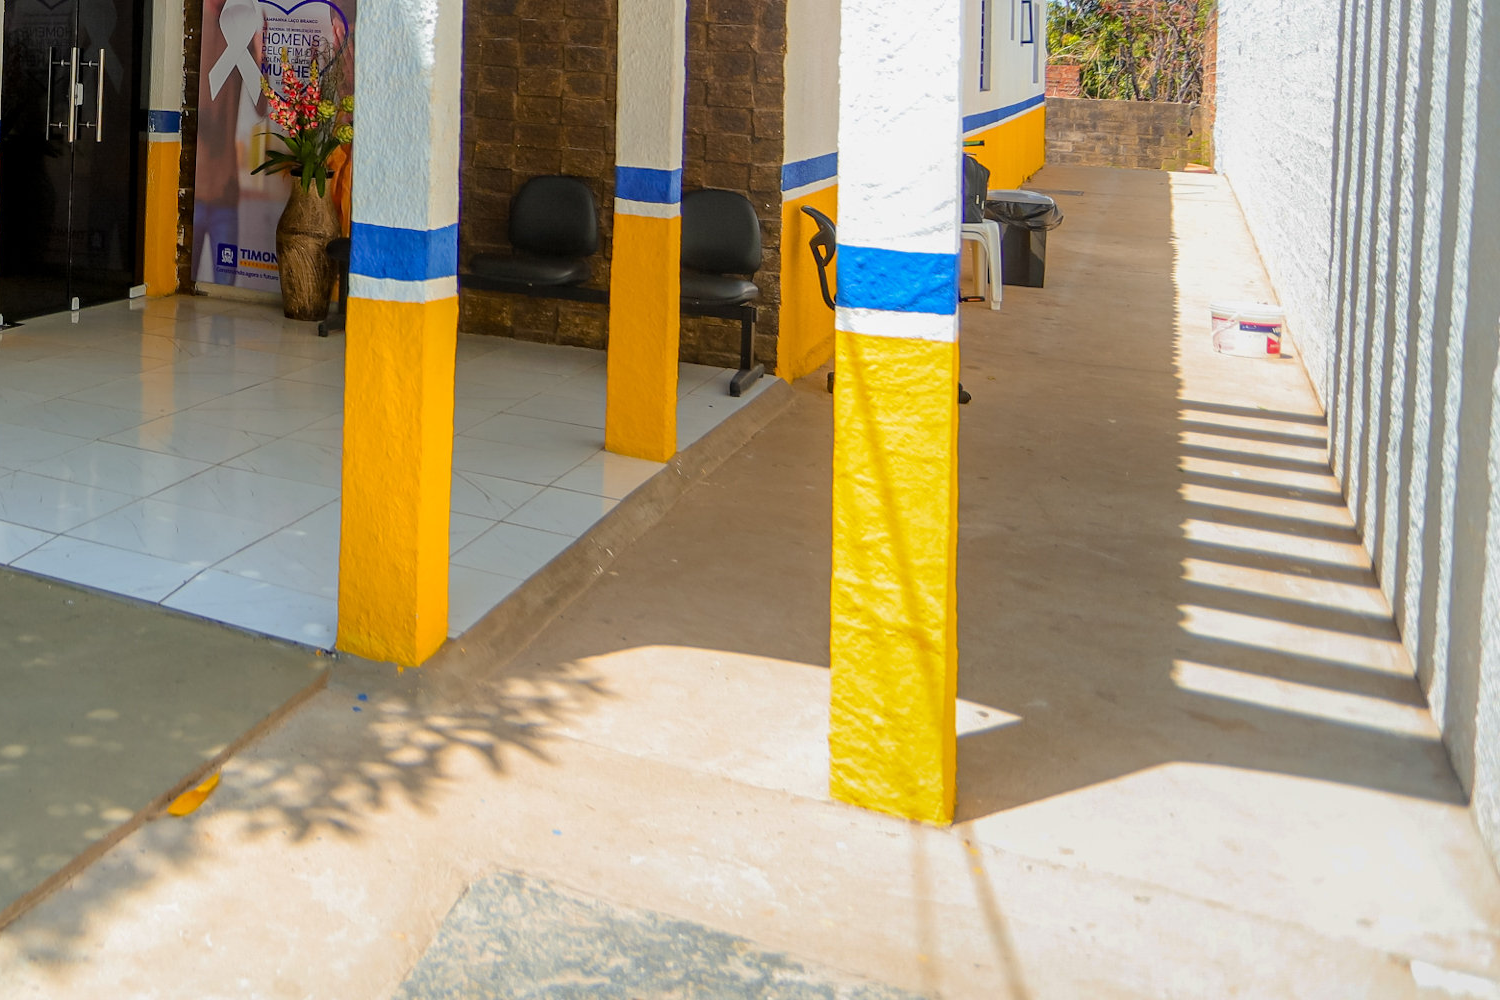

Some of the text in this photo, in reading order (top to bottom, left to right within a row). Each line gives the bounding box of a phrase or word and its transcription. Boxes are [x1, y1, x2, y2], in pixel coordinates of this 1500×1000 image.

[262, 32, 320, 47] HOMENS
[287, 47, 303, 56] FIM
[261, 63, 311, 78] MUHE
[240, 248, 278, 263] TIMON
